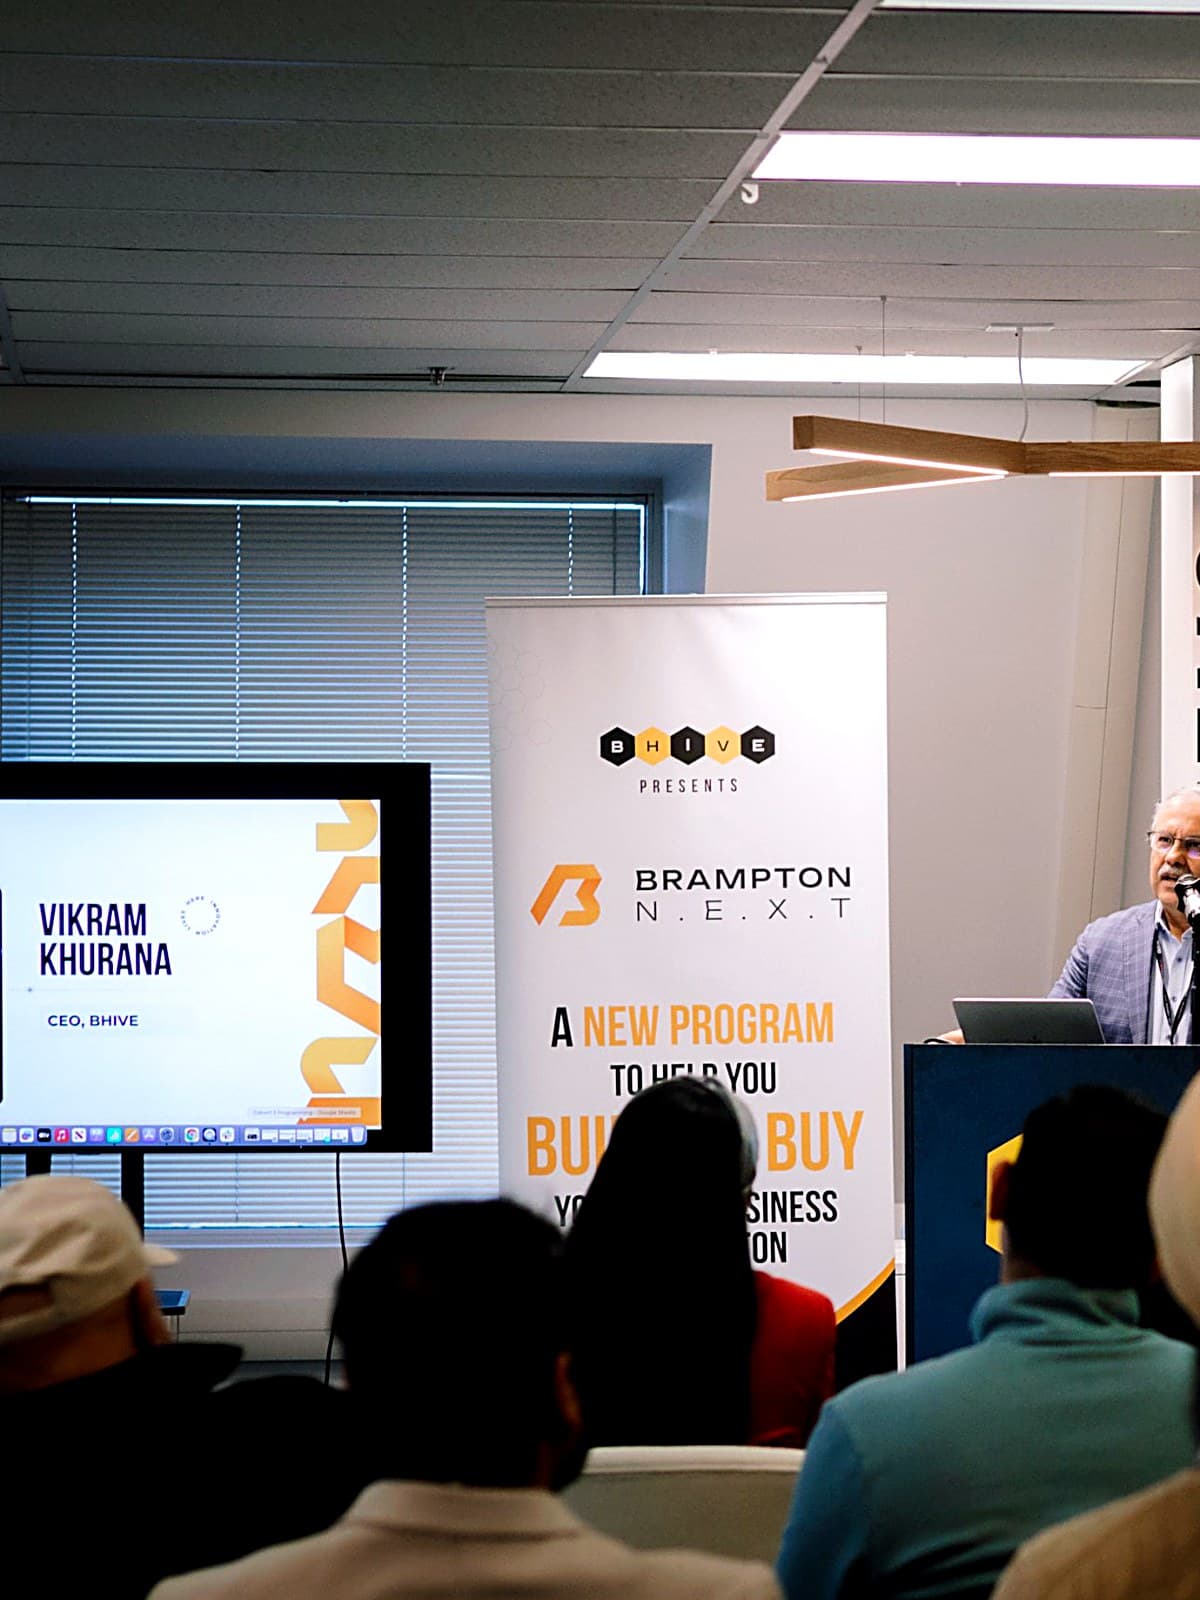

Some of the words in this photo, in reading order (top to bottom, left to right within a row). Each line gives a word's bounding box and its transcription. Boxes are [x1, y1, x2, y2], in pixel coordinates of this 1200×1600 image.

[639, 778, 739, 794] PRESENTS
[635, 867, 852, 891] BRAMPTON
[39, 903, 147, 936] VIKRAM
[40, 943, 172, 976] KHURANA
[47, 1015, 85, 1028] CEO,
[90, 1015, 139, 1027] BHIVE
[551, 1007, 574, 1047] A
[583, 1005, 660, 1046] NEW
[670, 1002, 834, 1044] PROGRAM
[610, 1064, 643, 1096] TO
[725, 1062, 776, 1094] YOU
[527, 1114, 620, 1176] BUI
[767, 1110, 864, 1172] BUY
[746, 1190, 838, 1224] SINESS
